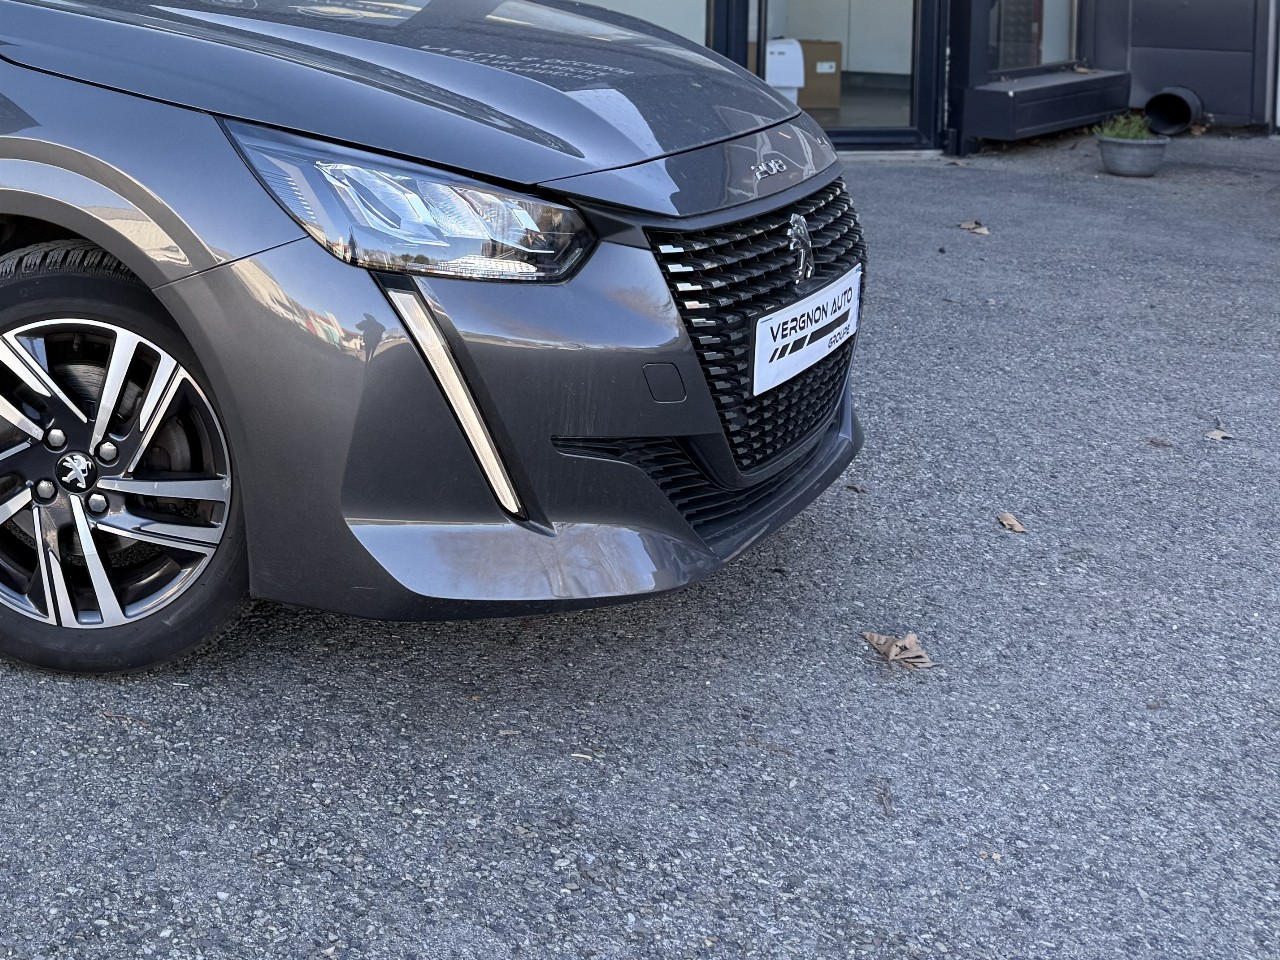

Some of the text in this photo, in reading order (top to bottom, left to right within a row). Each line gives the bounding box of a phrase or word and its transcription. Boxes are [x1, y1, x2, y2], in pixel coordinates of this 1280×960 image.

[751, 158, 787, 180] 208
[770, 286, 853, 342] VERGNON AUTO
[827, 325, 850, 349] GROUPE
